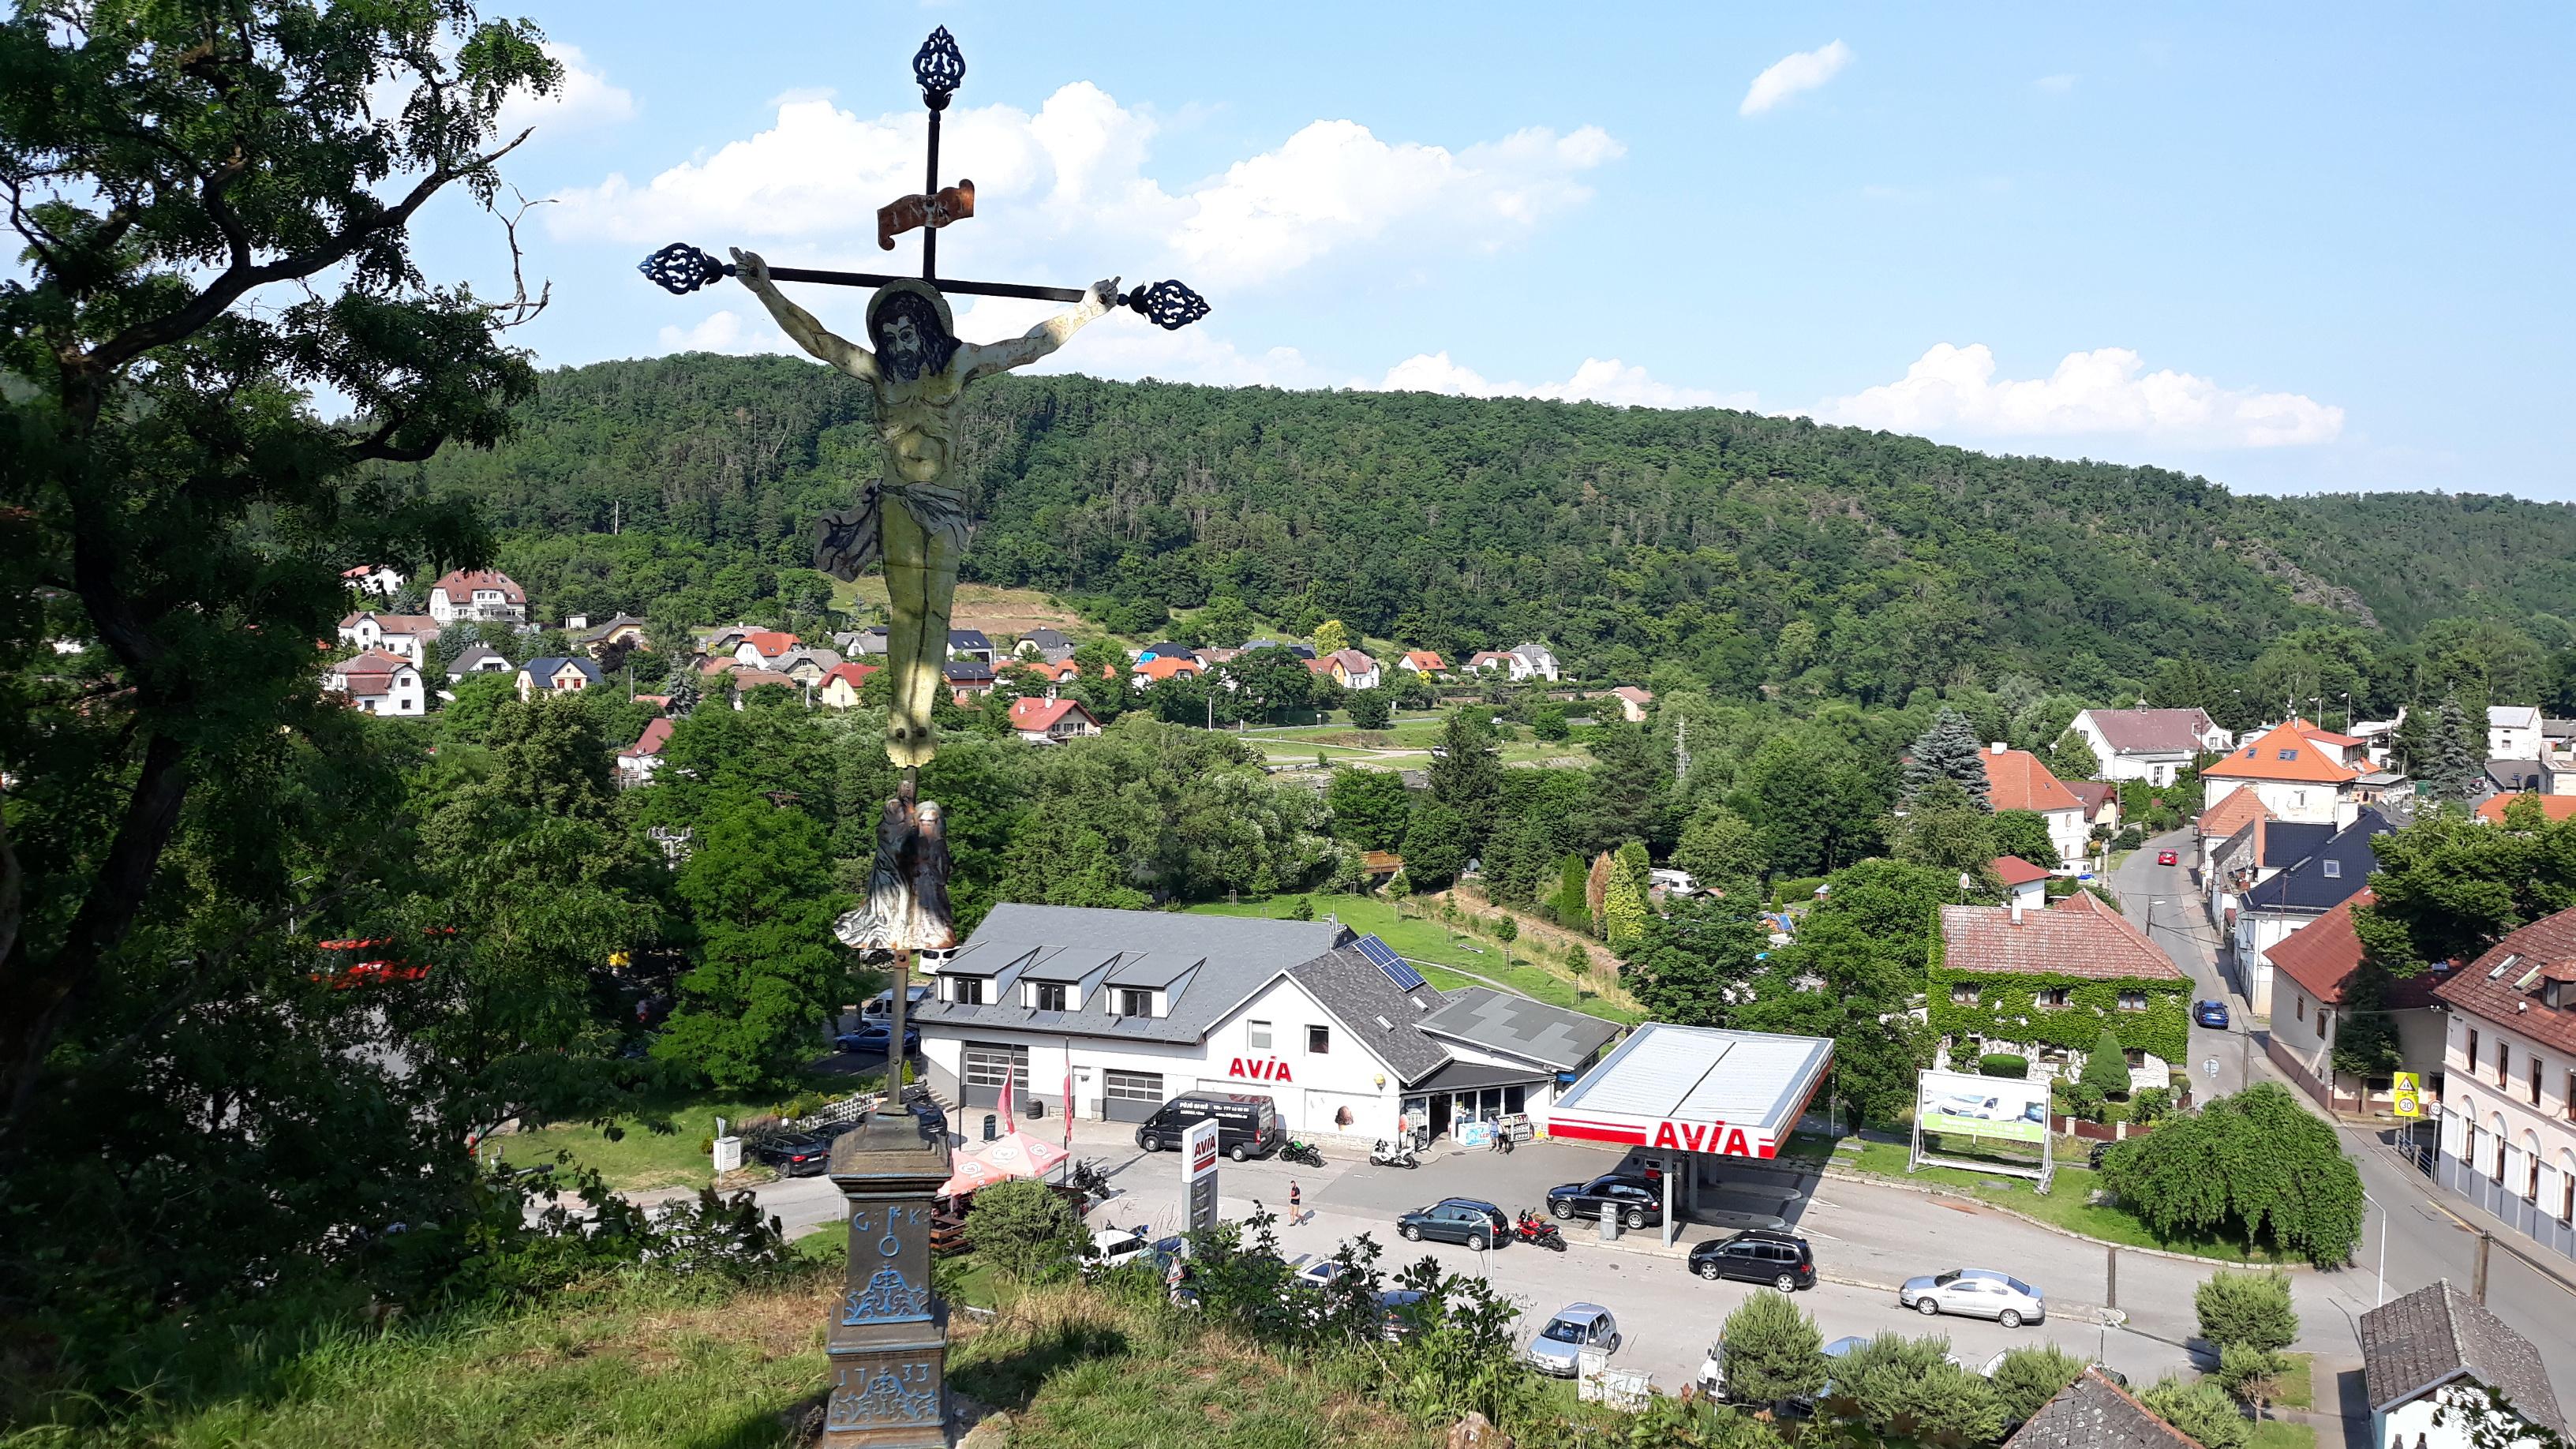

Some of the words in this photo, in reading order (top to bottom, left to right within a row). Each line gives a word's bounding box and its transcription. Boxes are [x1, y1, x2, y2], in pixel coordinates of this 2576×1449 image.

[1229, 1056, 1293, 1082] AVIA
[1194, 1133, 1215, 1158] AVIA
[1654, 1121, 1750, 1157] AVIA
